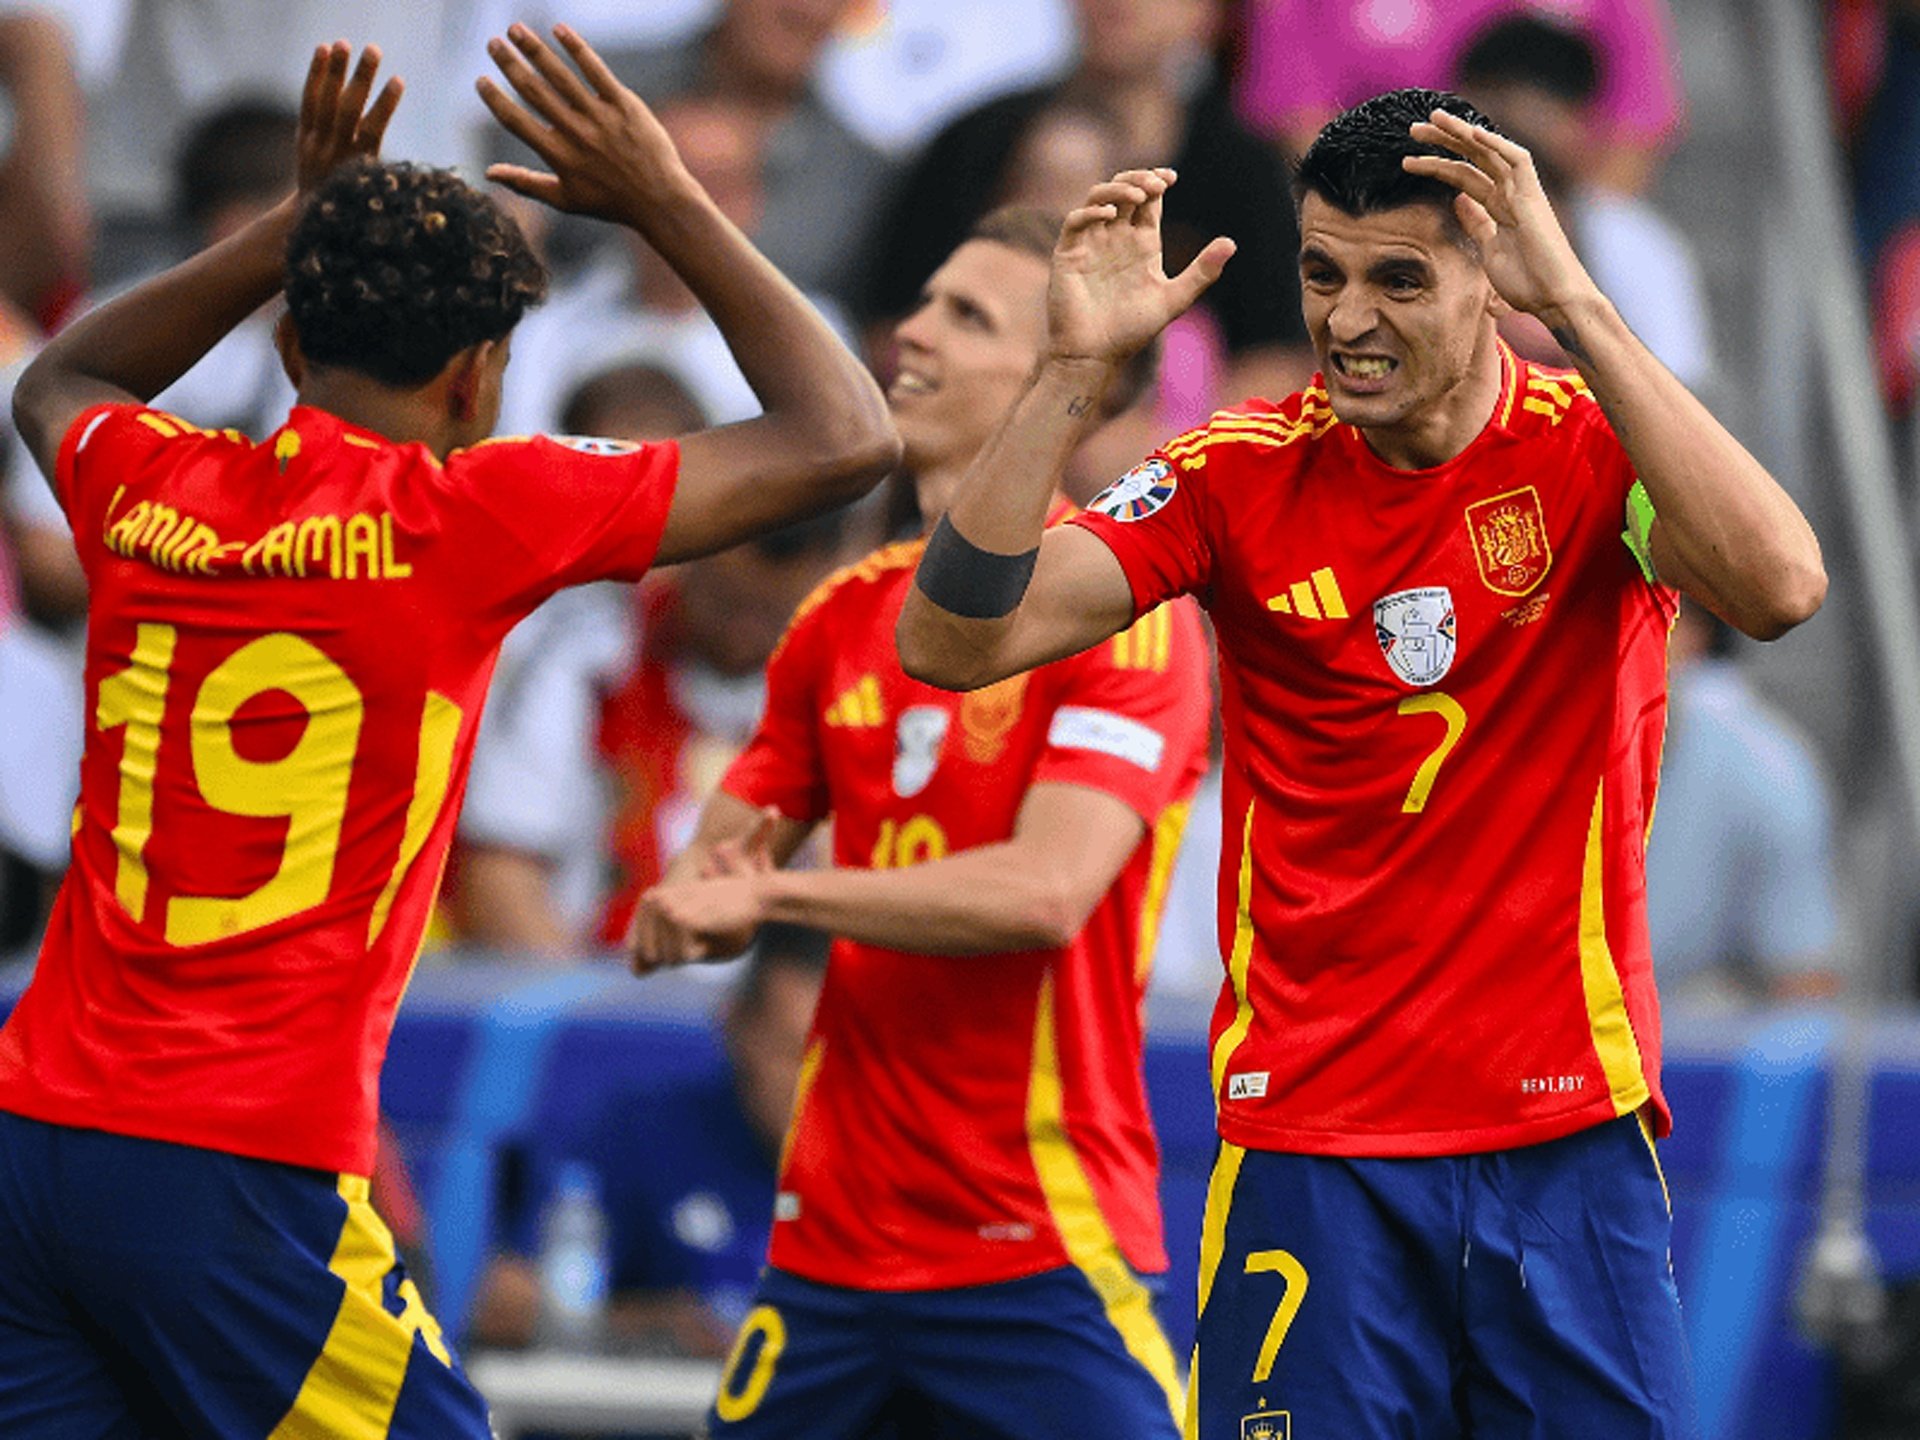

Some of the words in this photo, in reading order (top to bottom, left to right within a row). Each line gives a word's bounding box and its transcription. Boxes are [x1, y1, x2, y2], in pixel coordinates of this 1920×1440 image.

[97, 623, 364, 947] 19
[1398, 692, 1467, 813] 7
[1243, 1249, 1309, 1384] 7
